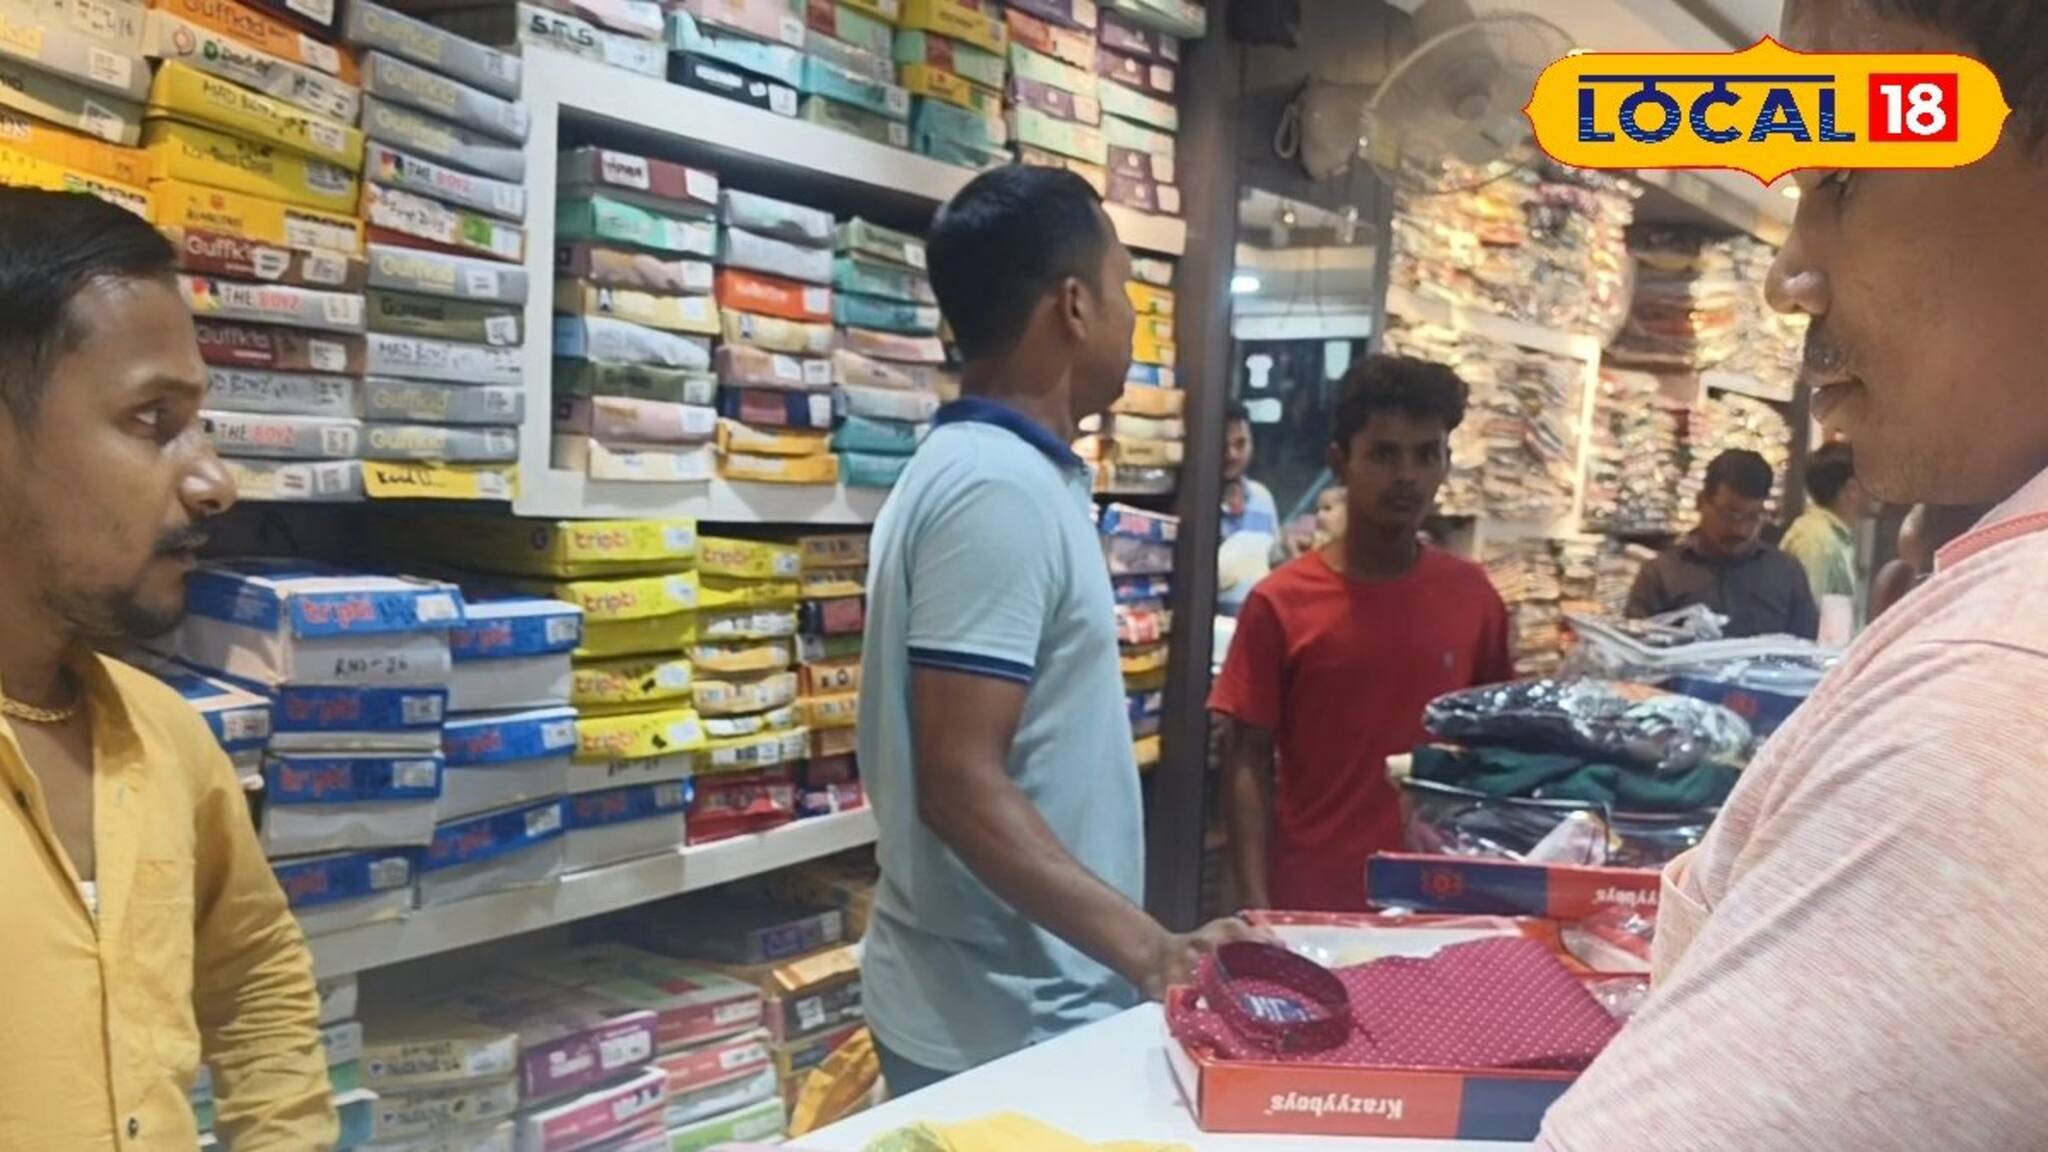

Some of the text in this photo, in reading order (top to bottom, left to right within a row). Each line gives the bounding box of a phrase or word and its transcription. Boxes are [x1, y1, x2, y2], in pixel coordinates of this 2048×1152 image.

[407, 161, 431, 182] THE
[224, 286, 252, 306] THE
[219, 422, 247, 442] THE
[1268, 1092, 1404, 1120] Krazyyboys
